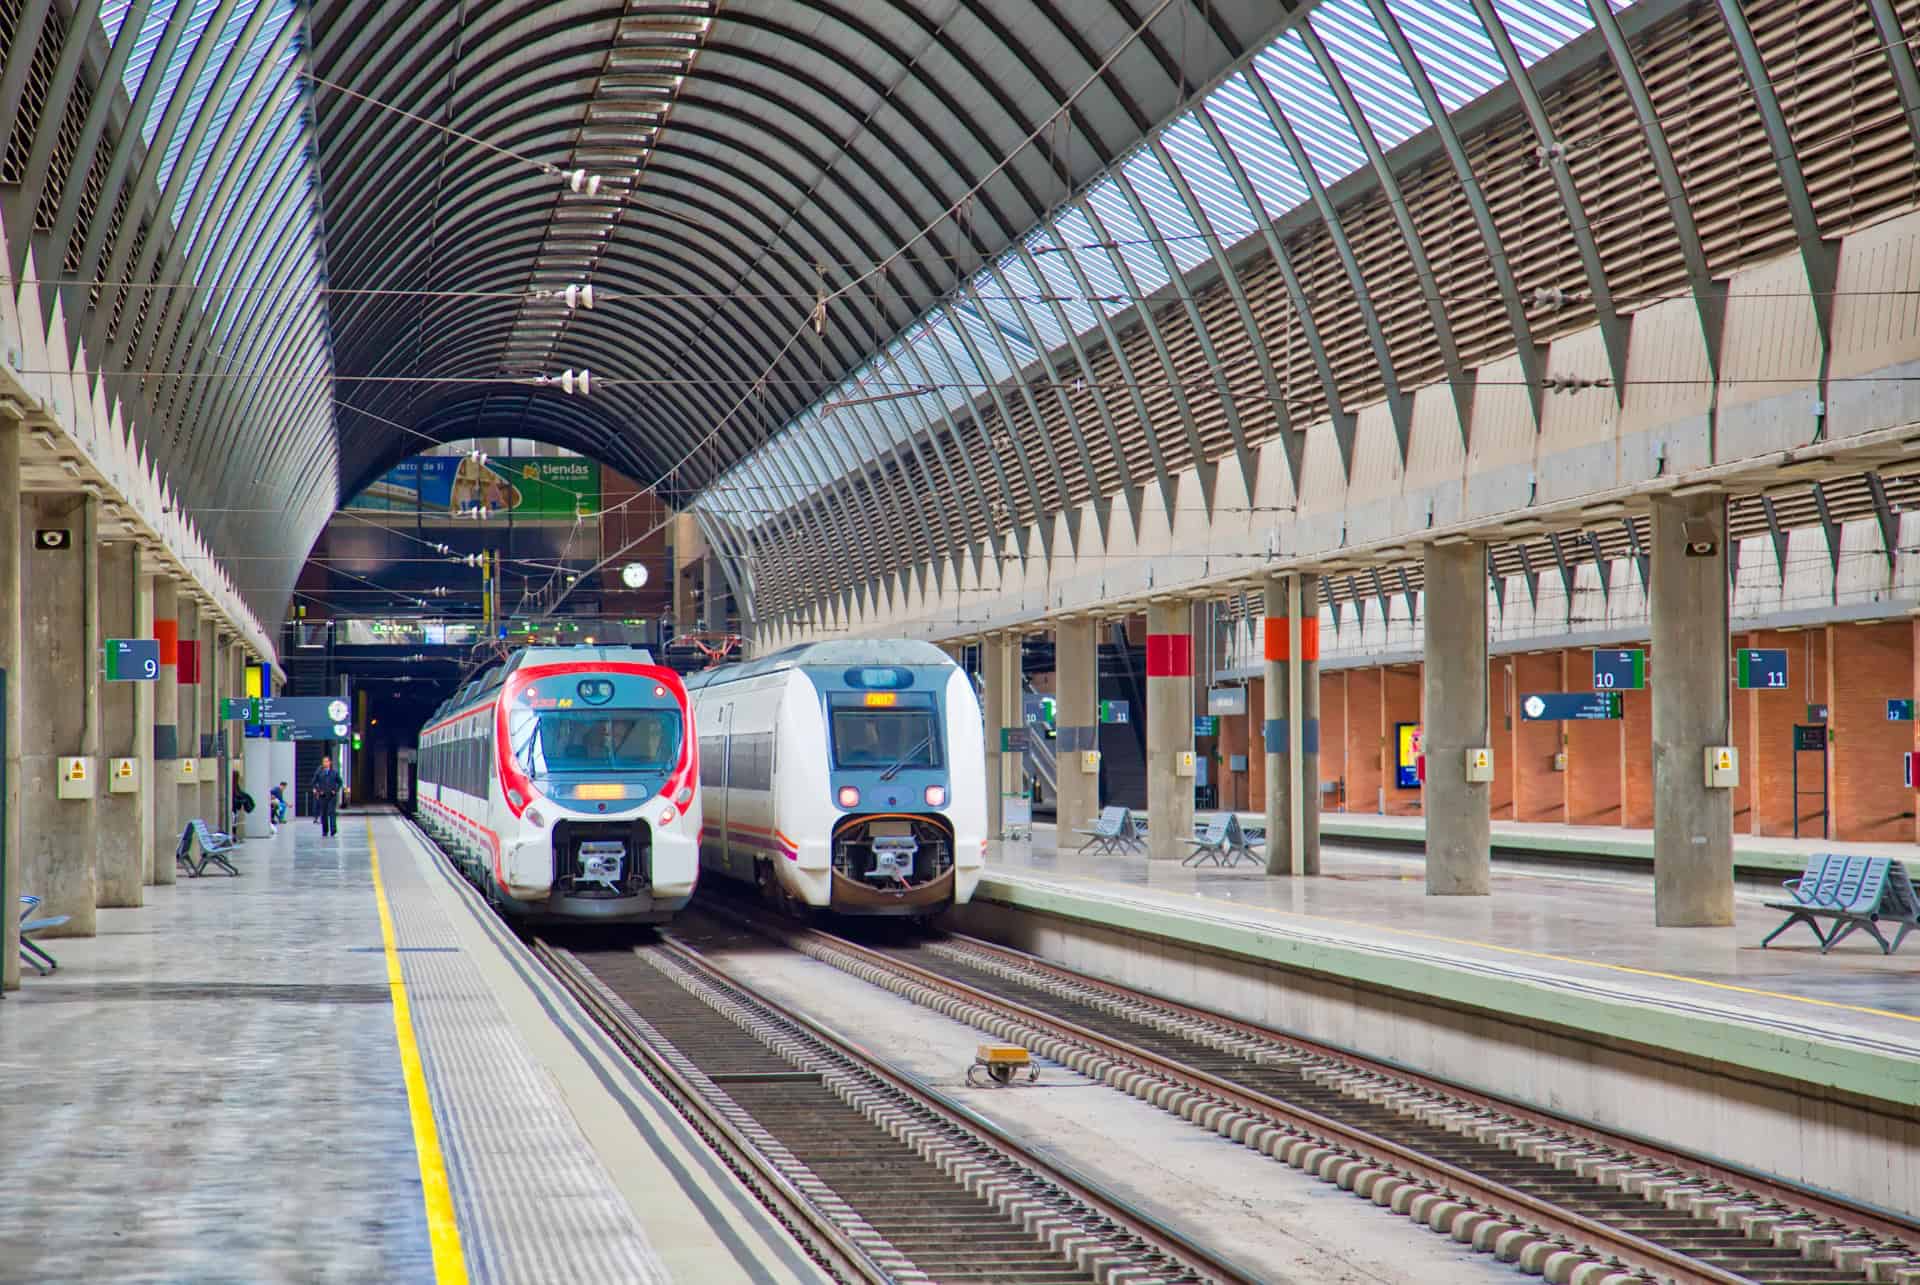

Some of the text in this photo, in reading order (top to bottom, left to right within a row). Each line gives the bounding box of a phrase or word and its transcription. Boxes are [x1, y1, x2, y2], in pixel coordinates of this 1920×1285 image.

[542, 463, 589, 474] tiendas
[144, 659, 156, 678] 9
[1596, 672, 1614, 688] 10
[1767, 671, 1786, 687] 11
[241, 707, 250, 719] 9
[1026, 713, 1037, 722] 10
[1117, 712, 1127, 721] 11
